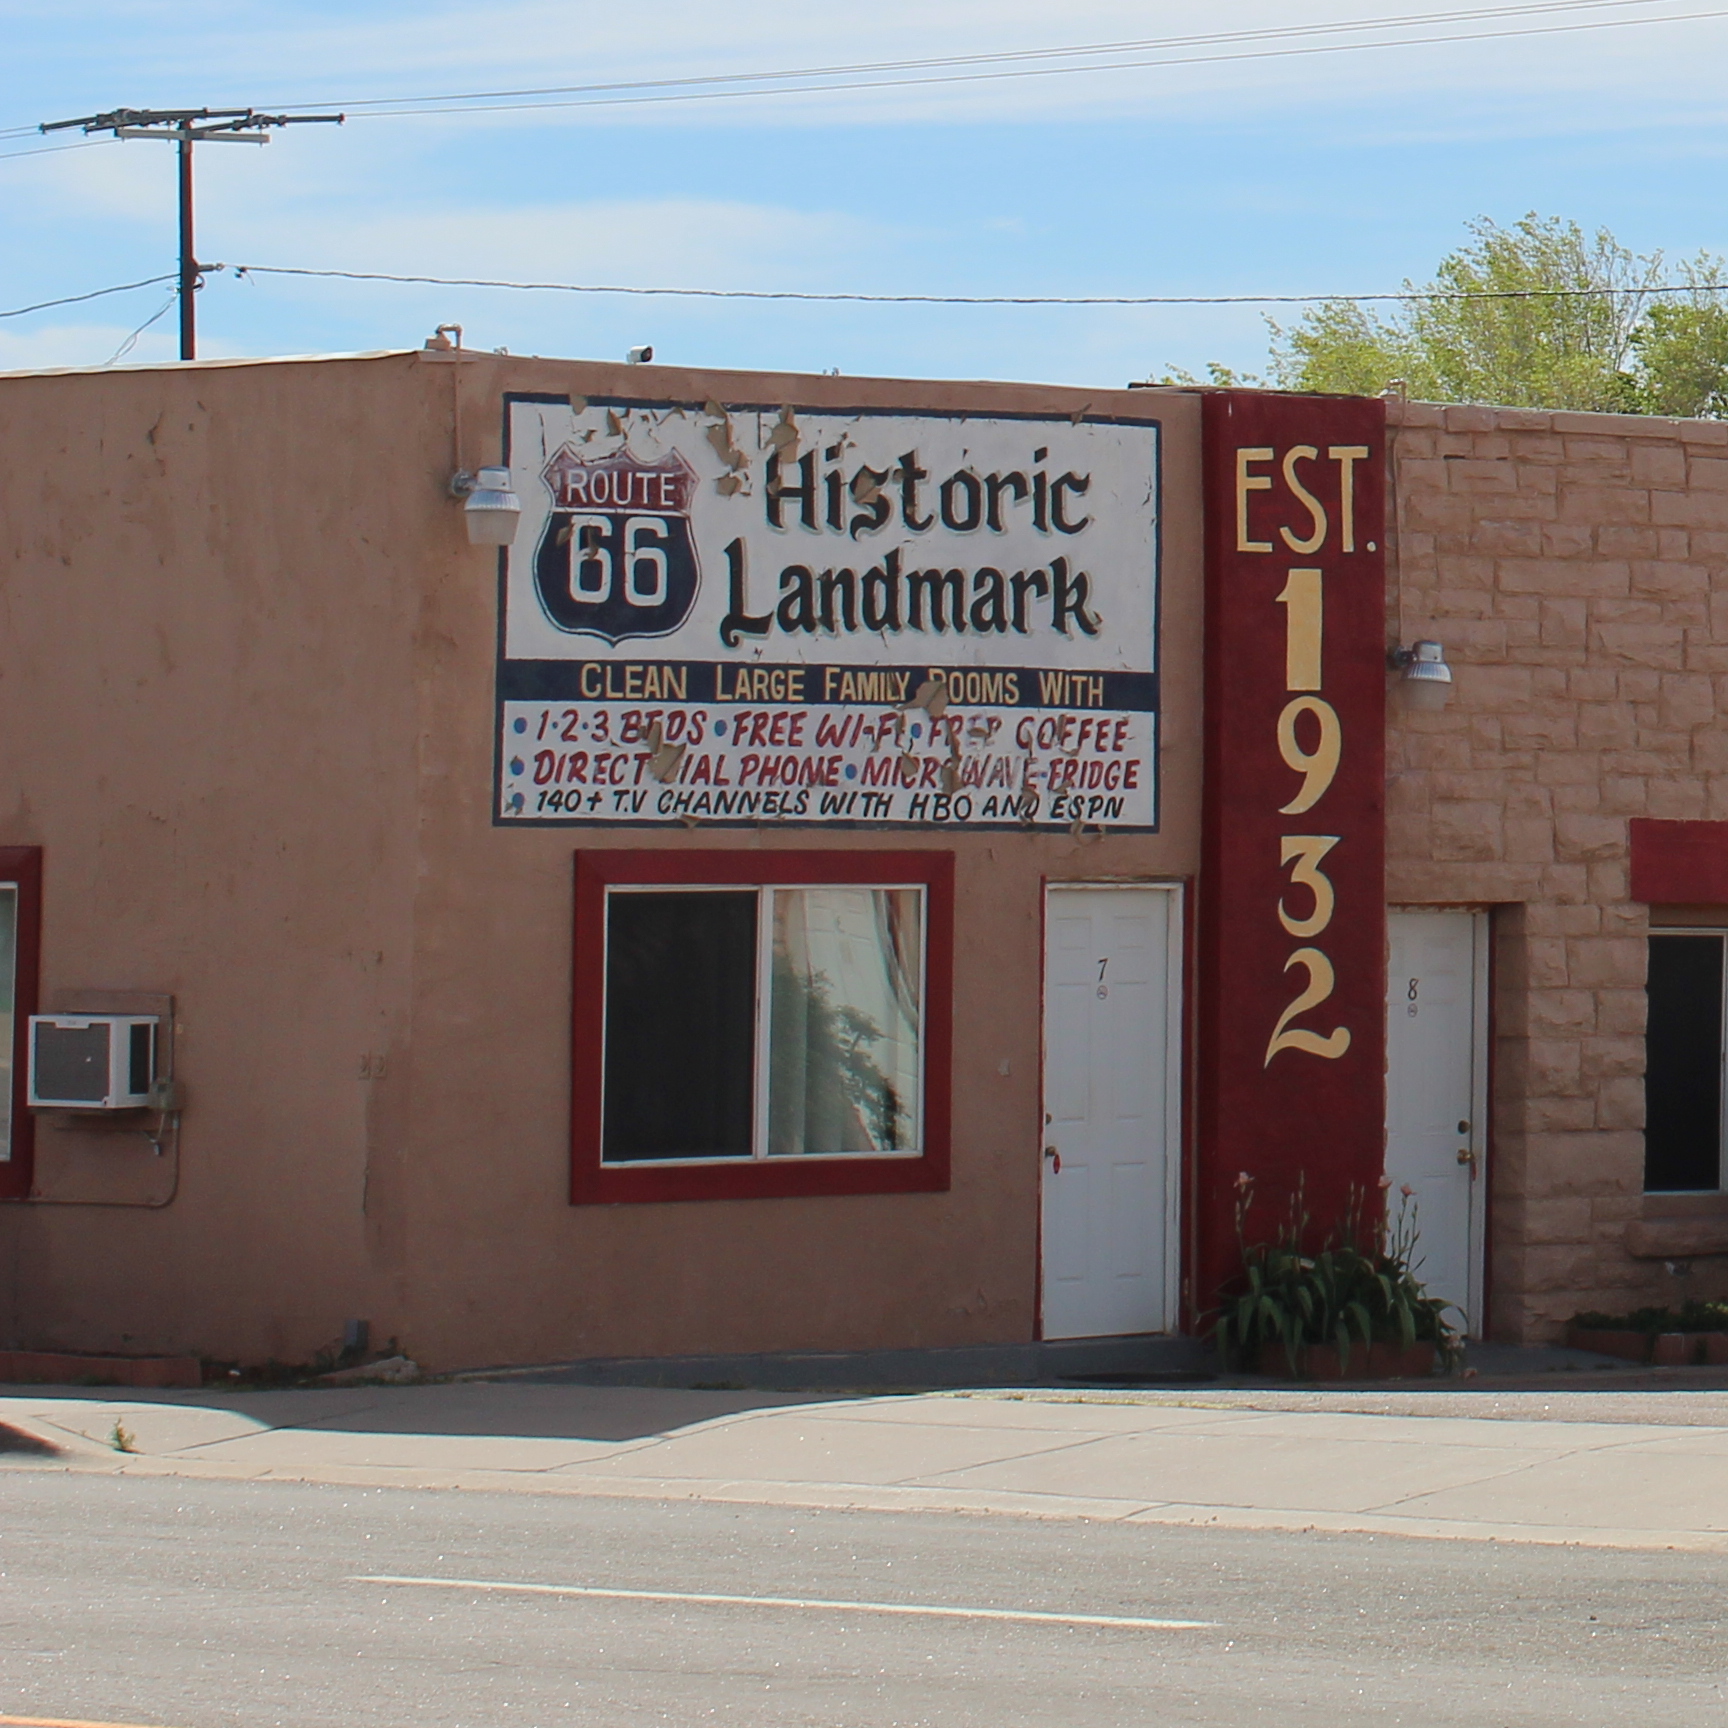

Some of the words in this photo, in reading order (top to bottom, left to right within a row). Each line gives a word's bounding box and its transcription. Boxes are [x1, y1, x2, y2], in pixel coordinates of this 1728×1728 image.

[566, 468, 676, 506] ROUTE
[765, 445, 1092, 542] Historic
[1235, 444, 1377, 555] EST.
[569, 513, 669, 607] 66
[719, 536, 1102, 648] Landmark
[580, 662, 688, 700] CLEAN
[714, 664, 806, 702] LARGE
[825, 666, 911, 702] FAMILY
[1039, 671, 1105, 708] WITH
[731, 711, 808, 747] FREE
[1015, 715, 1130, 753] COFFEE
[533, 749, 653, 786] DIRECT
[664, 753, 731, 786] IAL
[737, 754, 844, 787] PHONE
[860, 754, 1039, 790] MICRWAVE
[657, 789, 811, 815] CHANNELS
[819, 791, 894, 817] WITH
[908, 792, 972, 821] HBO
[981, 793, 1041, 819] AND
[1049, 793, 1125, 820] ESPN
[1263, 568, 1352, 1070] 1932
[1097, 957, 1109, 982] 7
[1408, 977, 1420, 1001] 8
